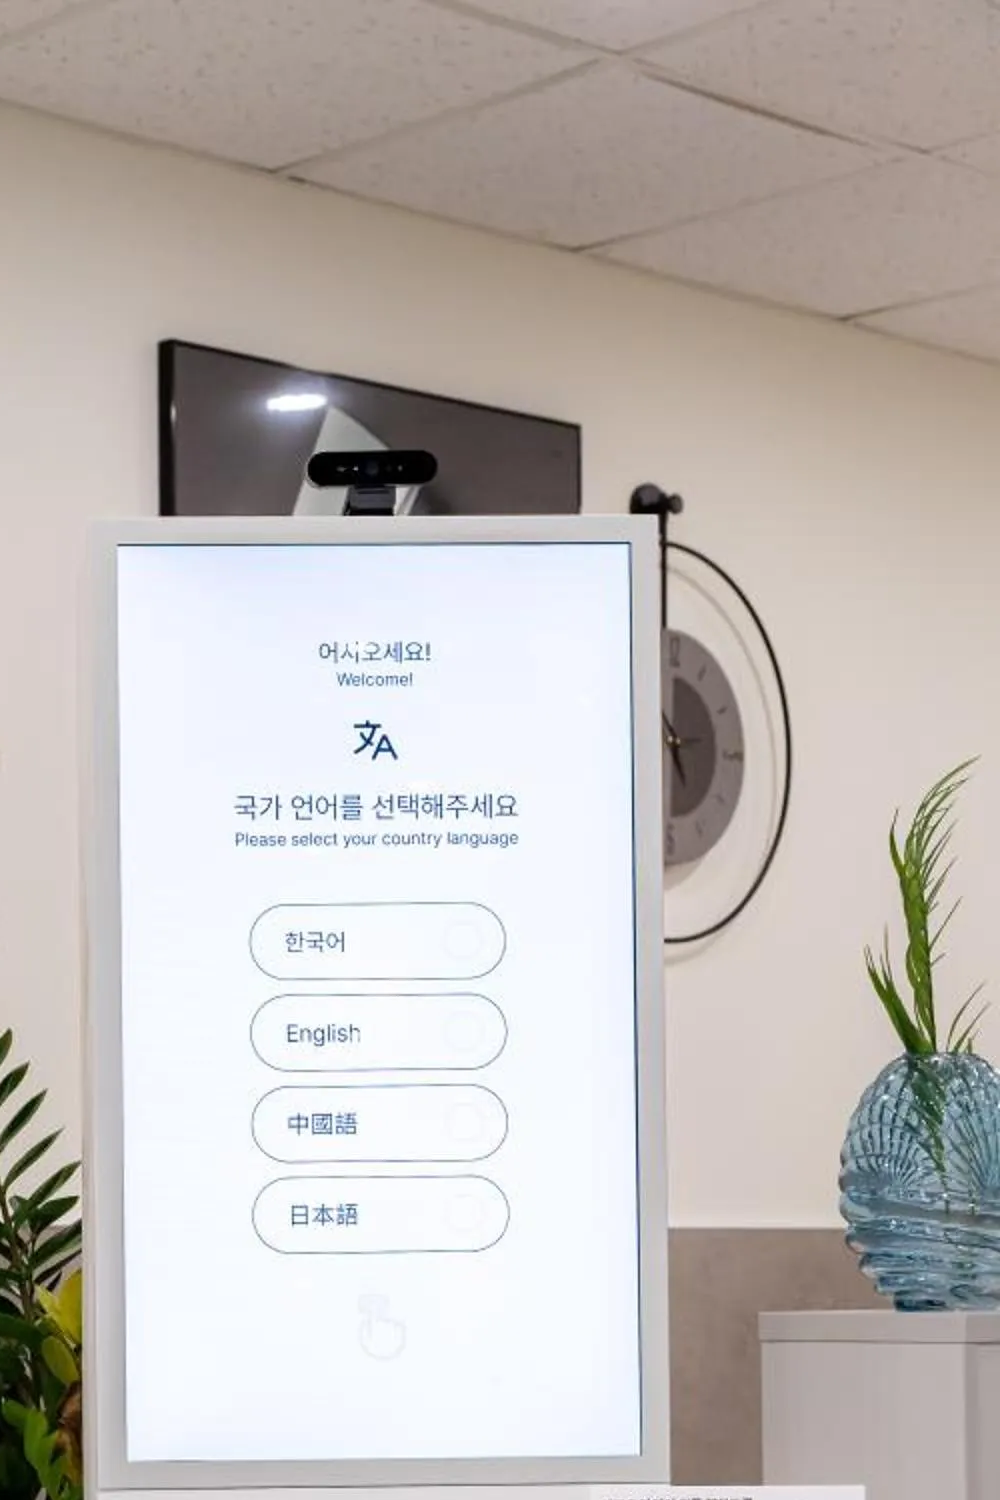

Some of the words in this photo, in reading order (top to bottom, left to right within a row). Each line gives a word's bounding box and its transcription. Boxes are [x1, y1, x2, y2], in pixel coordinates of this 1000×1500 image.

[336, 673, 413, 687] Welcome!
[234, 795, 282, 820] 국가
[292, 795, 364, 820] 언어를
[372, 795, 519, 820] 선택해주세요
[235, 832, 286, 847] Please
[292, 832, 338, 847] select
[344, 832, 376, 847] your
[382, 832, 442, 847] country
[447, 832, 519, 847] language
[286, 931, 345, 953] 한국어
[286, 1024, 360, 1047] English
[288, 1113, 358, 1135] 中國語
[291, 1204, 358, 1227] 日本語
